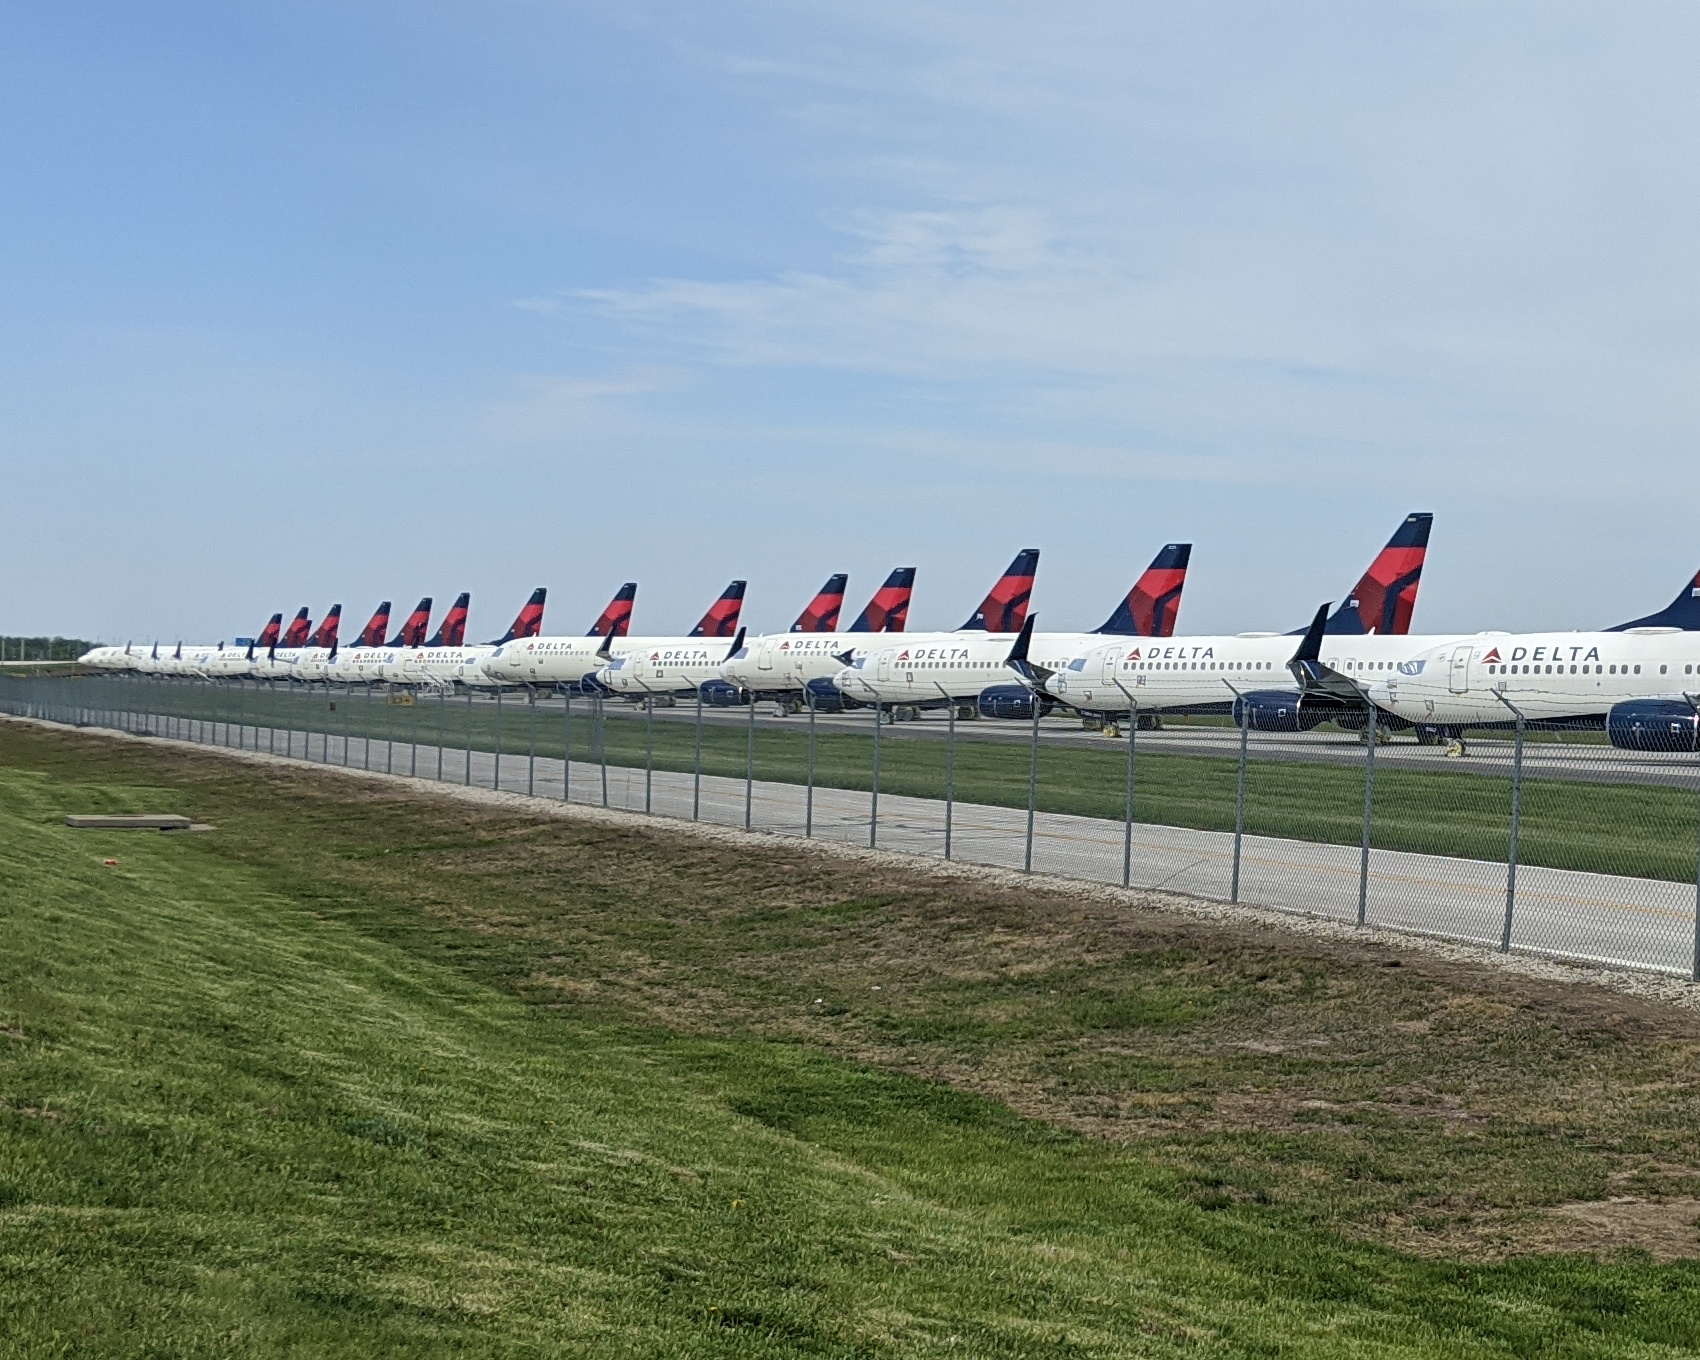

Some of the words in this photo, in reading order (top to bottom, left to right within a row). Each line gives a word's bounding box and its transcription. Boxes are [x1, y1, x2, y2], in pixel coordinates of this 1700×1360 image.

[794, 640, 839, 649] DELTA
[663, 651, 708, 660] DELTA
[914, 649, 969, 660] DELTA
[1147, 647, 1214, 659] DELTA
[1510, 647, 1600, 662] DELTA
